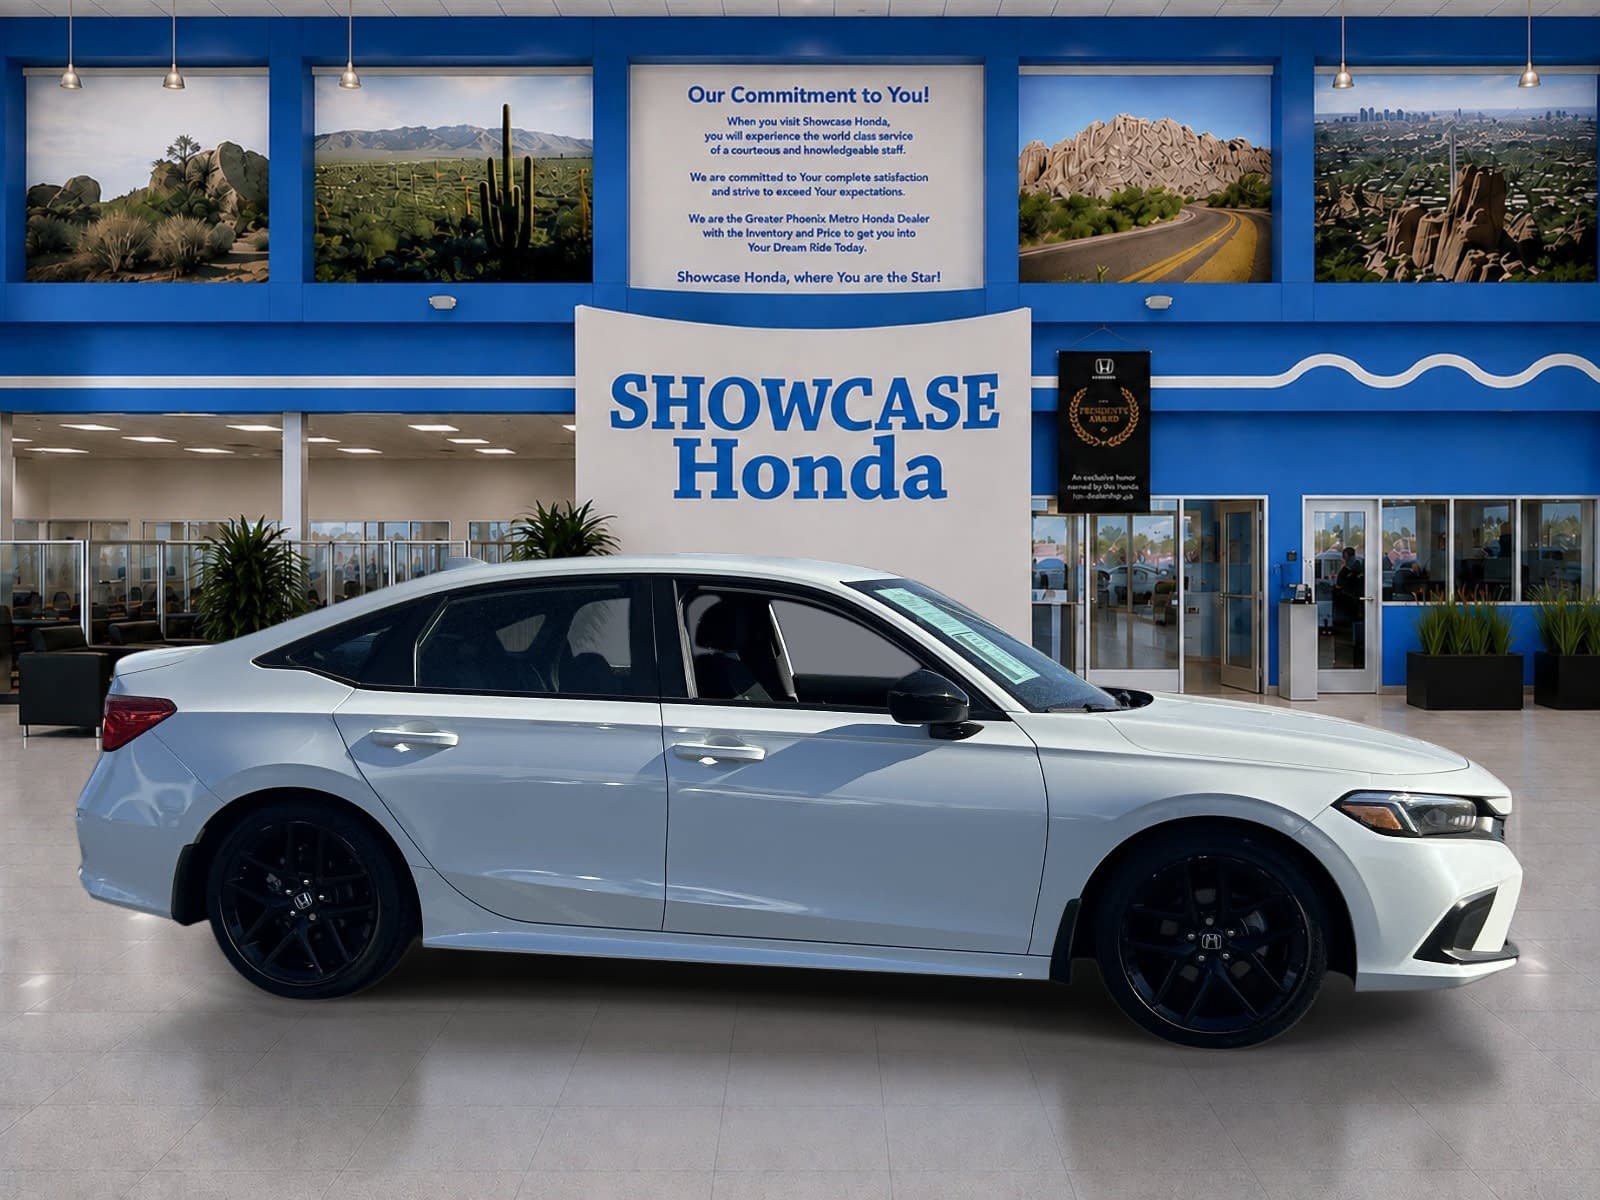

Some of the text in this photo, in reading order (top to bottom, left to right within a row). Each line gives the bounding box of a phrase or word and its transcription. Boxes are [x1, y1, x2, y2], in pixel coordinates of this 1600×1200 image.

[687, 85, 929, 104] Our Commitment to You!
[726, 116, 891, 129] When you visit Showcase Honda,
[704, 130, 914, 144] you will experience the world class service
[710, 144, 721, 155] of
[722, 147, 730, 155] a
[730, 146, 781, 155] courteous
[782, 144, 802, 155] and
[881, 144, 906, 155] staff.
[689, 171, 929, 185] We are committed to Your complete satisfaction
[711, 186, 906, 200] and strive to exceed Your expectations.
[688, 213, 930, 224] We are the Greater Phoenix Metro Honda Dealer
[702, 227, 917, 241] with the Inventory and Price to get you into
[747, 242, 867, 255] Your Dream Ride Today.
[677, 270, 941, 285] Showcase Honda, where You are the Star!
[610, 373, 1000, 431] SHOWCASE
[673, 434, 947, 500] Honda
[1071, 473, 1082, 481] An
[1093, 482, 1102, 493] by
